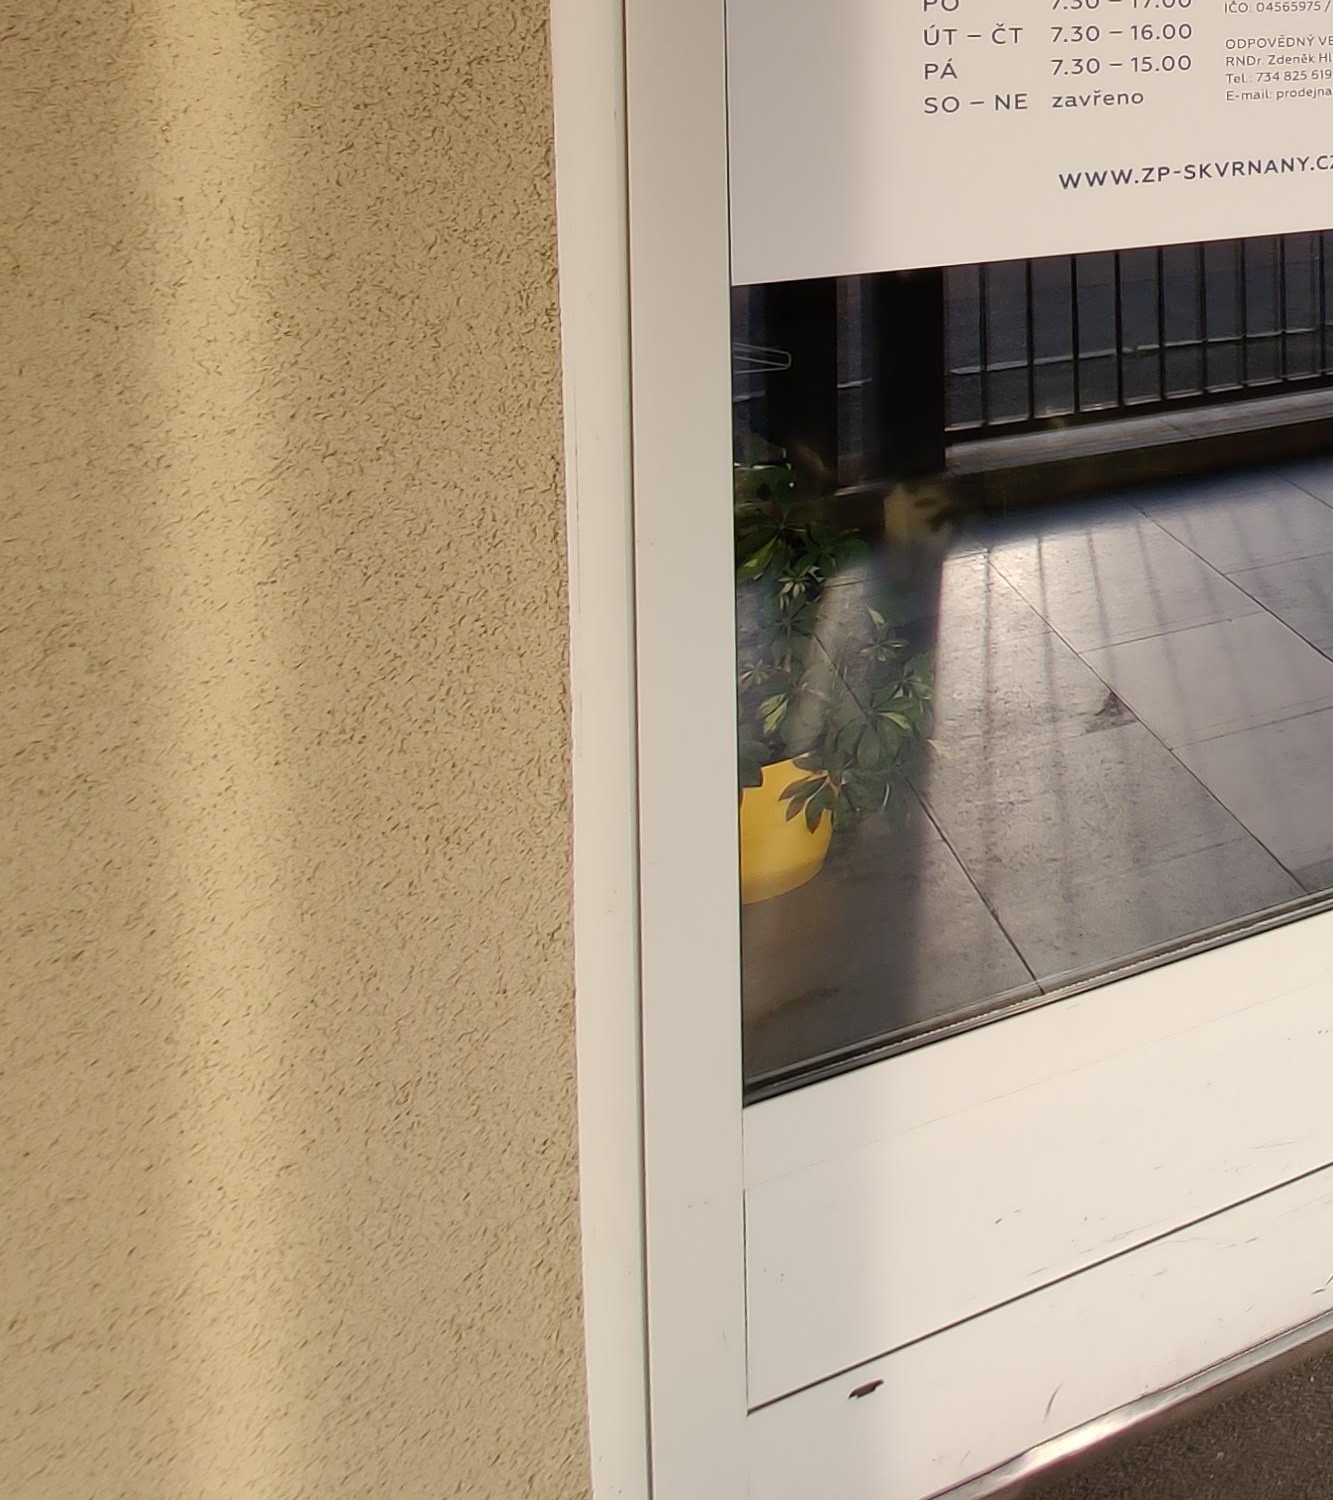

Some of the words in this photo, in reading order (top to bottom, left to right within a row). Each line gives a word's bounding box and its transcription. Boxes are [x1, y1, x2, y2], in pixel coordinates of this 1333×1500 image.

[1255, 0, 1321, 13] 04565975
[924, 25, 957, 45] ÚT
[992, 24, 1023, 44] ČT
[1050, 25, 1100, 43] 7.30
[1130, 23, 1192, 41] 16.00
[1225, 33, 1315, 50] ODPOVĚDNÝ
[925, 58, 957, 80] PÁ
[1050, 57, 1101, 76] 7.30
[1130, 54, 1192, 73] 15.00
[1267, 53, 1315, 66] Zdeněk
[1255, 71, 1280, 83] 734
[1283, 69, 1308, 82] 825
[923, 95, 960, 115] SO
[995, 93, 1028, 111] NE
[1051, 89, 1144, 109] zavřeno
